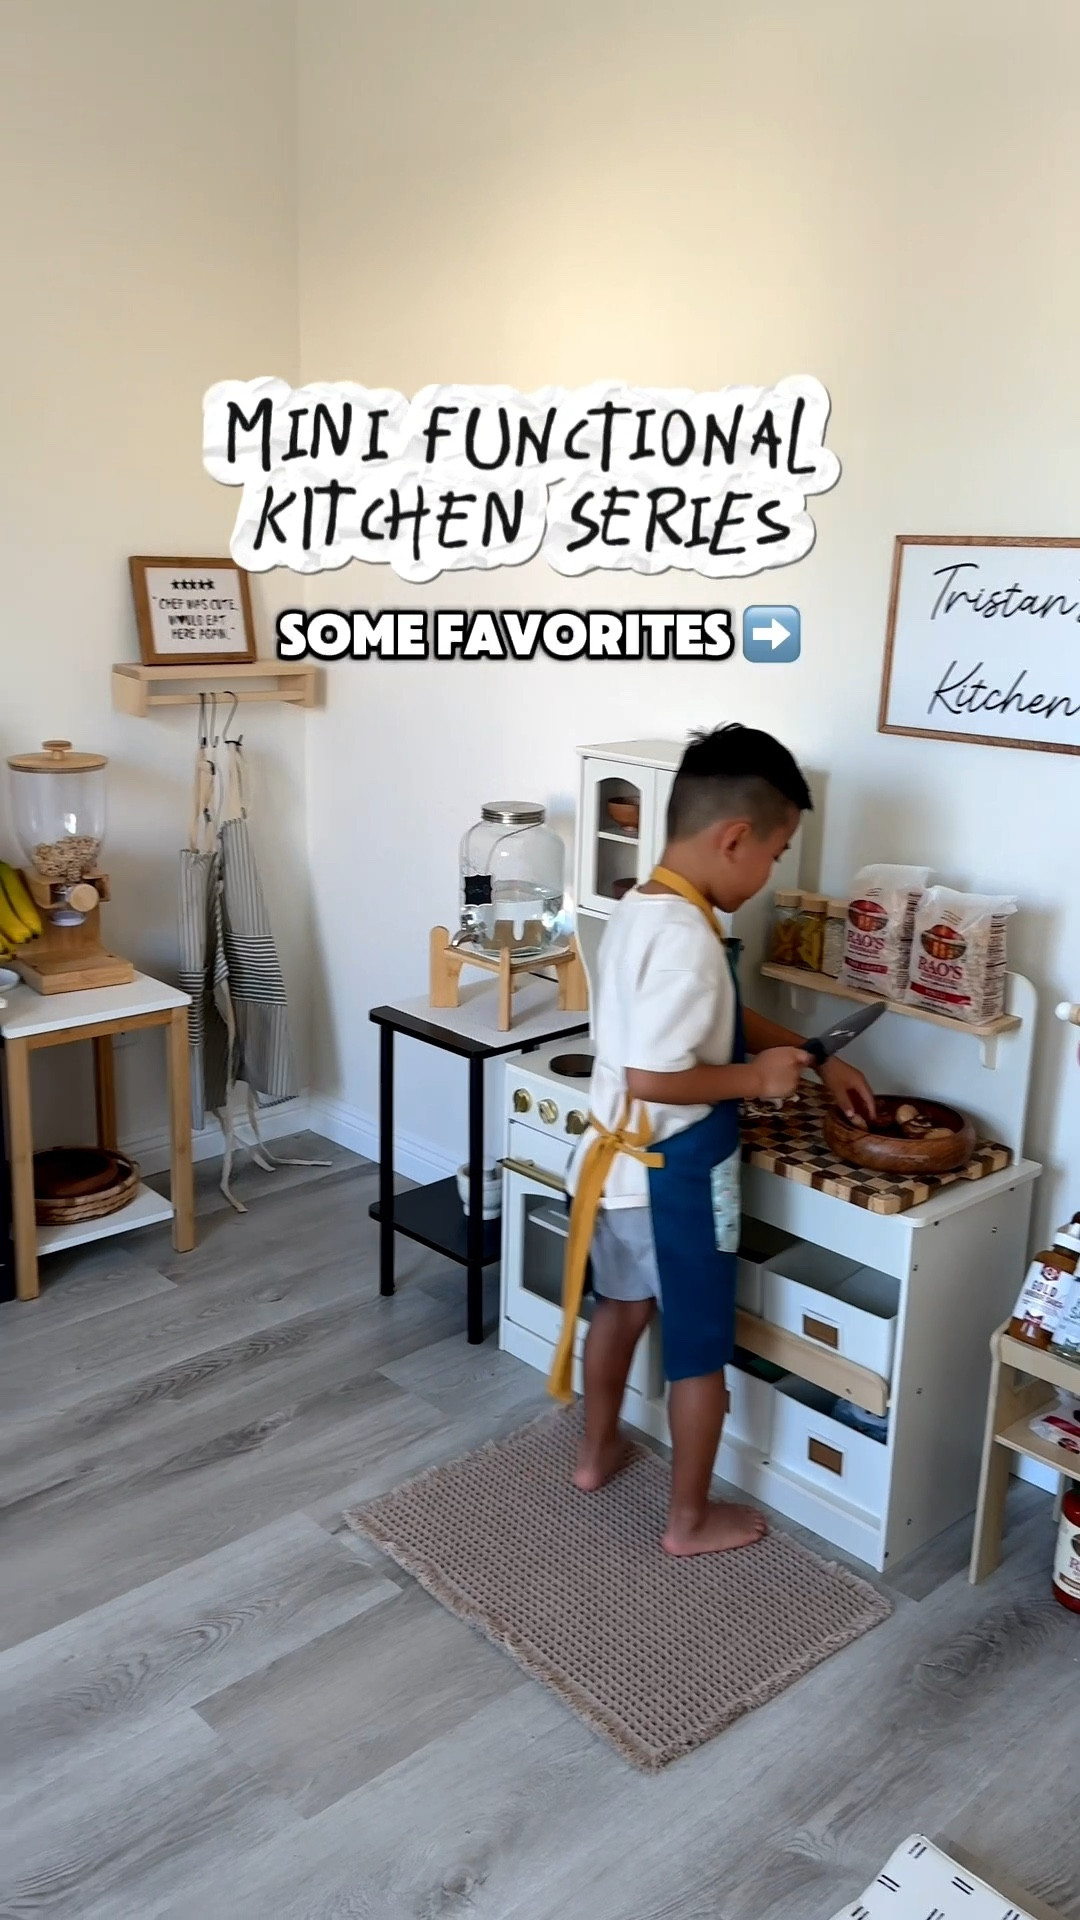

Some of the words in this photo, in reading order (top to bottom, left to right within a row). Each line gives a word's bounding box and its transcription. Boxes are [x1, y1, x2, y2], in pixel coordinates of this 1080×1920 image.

[930, 562, 1080, 624] Tristan
[927, 659, 1080, 720] Kitchen
[917, 955, 964, 980] RAO'S
